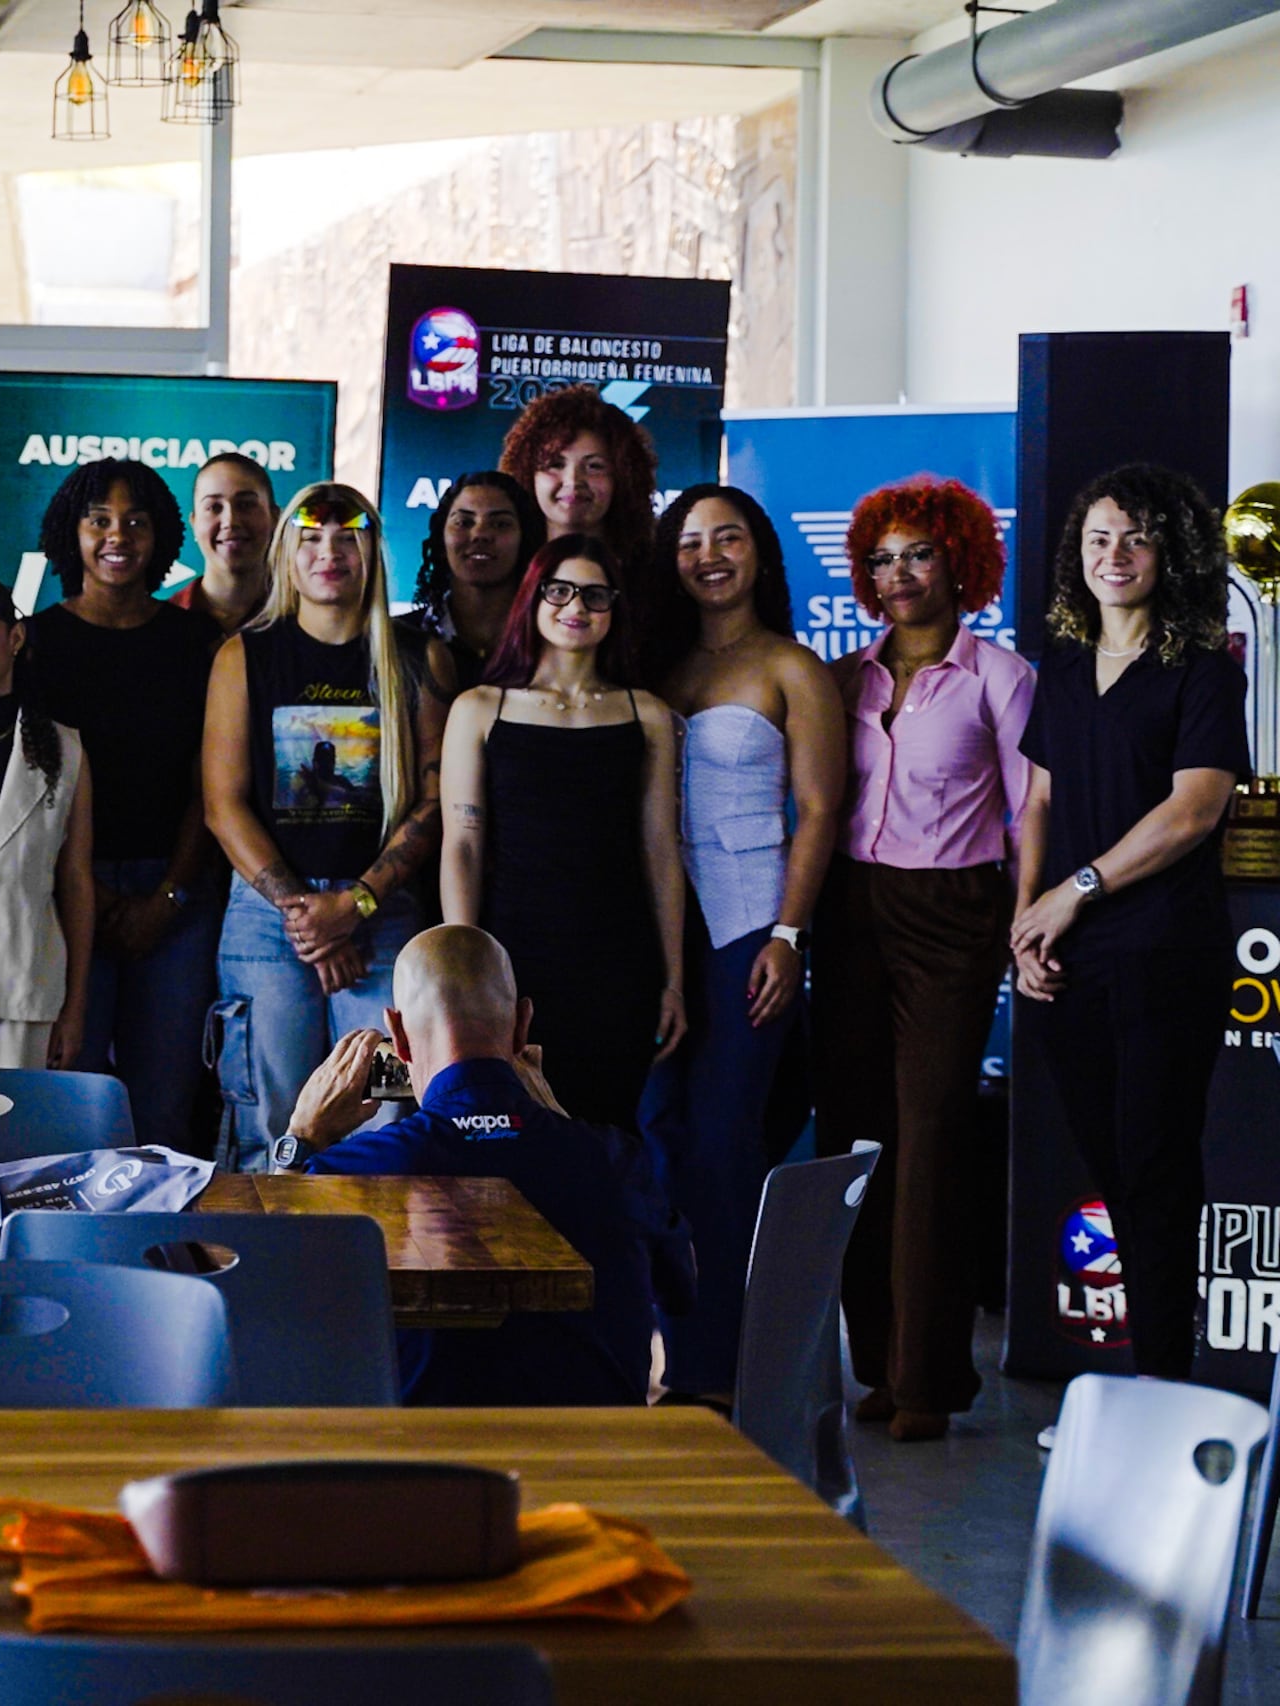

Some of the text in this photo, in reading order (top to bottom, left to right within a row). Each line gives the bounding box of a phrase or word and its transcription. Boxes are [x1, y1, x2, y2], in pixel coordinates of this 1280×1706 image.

[492, 334, 663, 360] LIGA DE BALONCESTO
[490, 355, 713, 384] PUERTORRIQUEÑA FEMENINA
[18, 434, 297, 472] AUSPICIADOR
[451, 1114, 511, 1134] wapa
